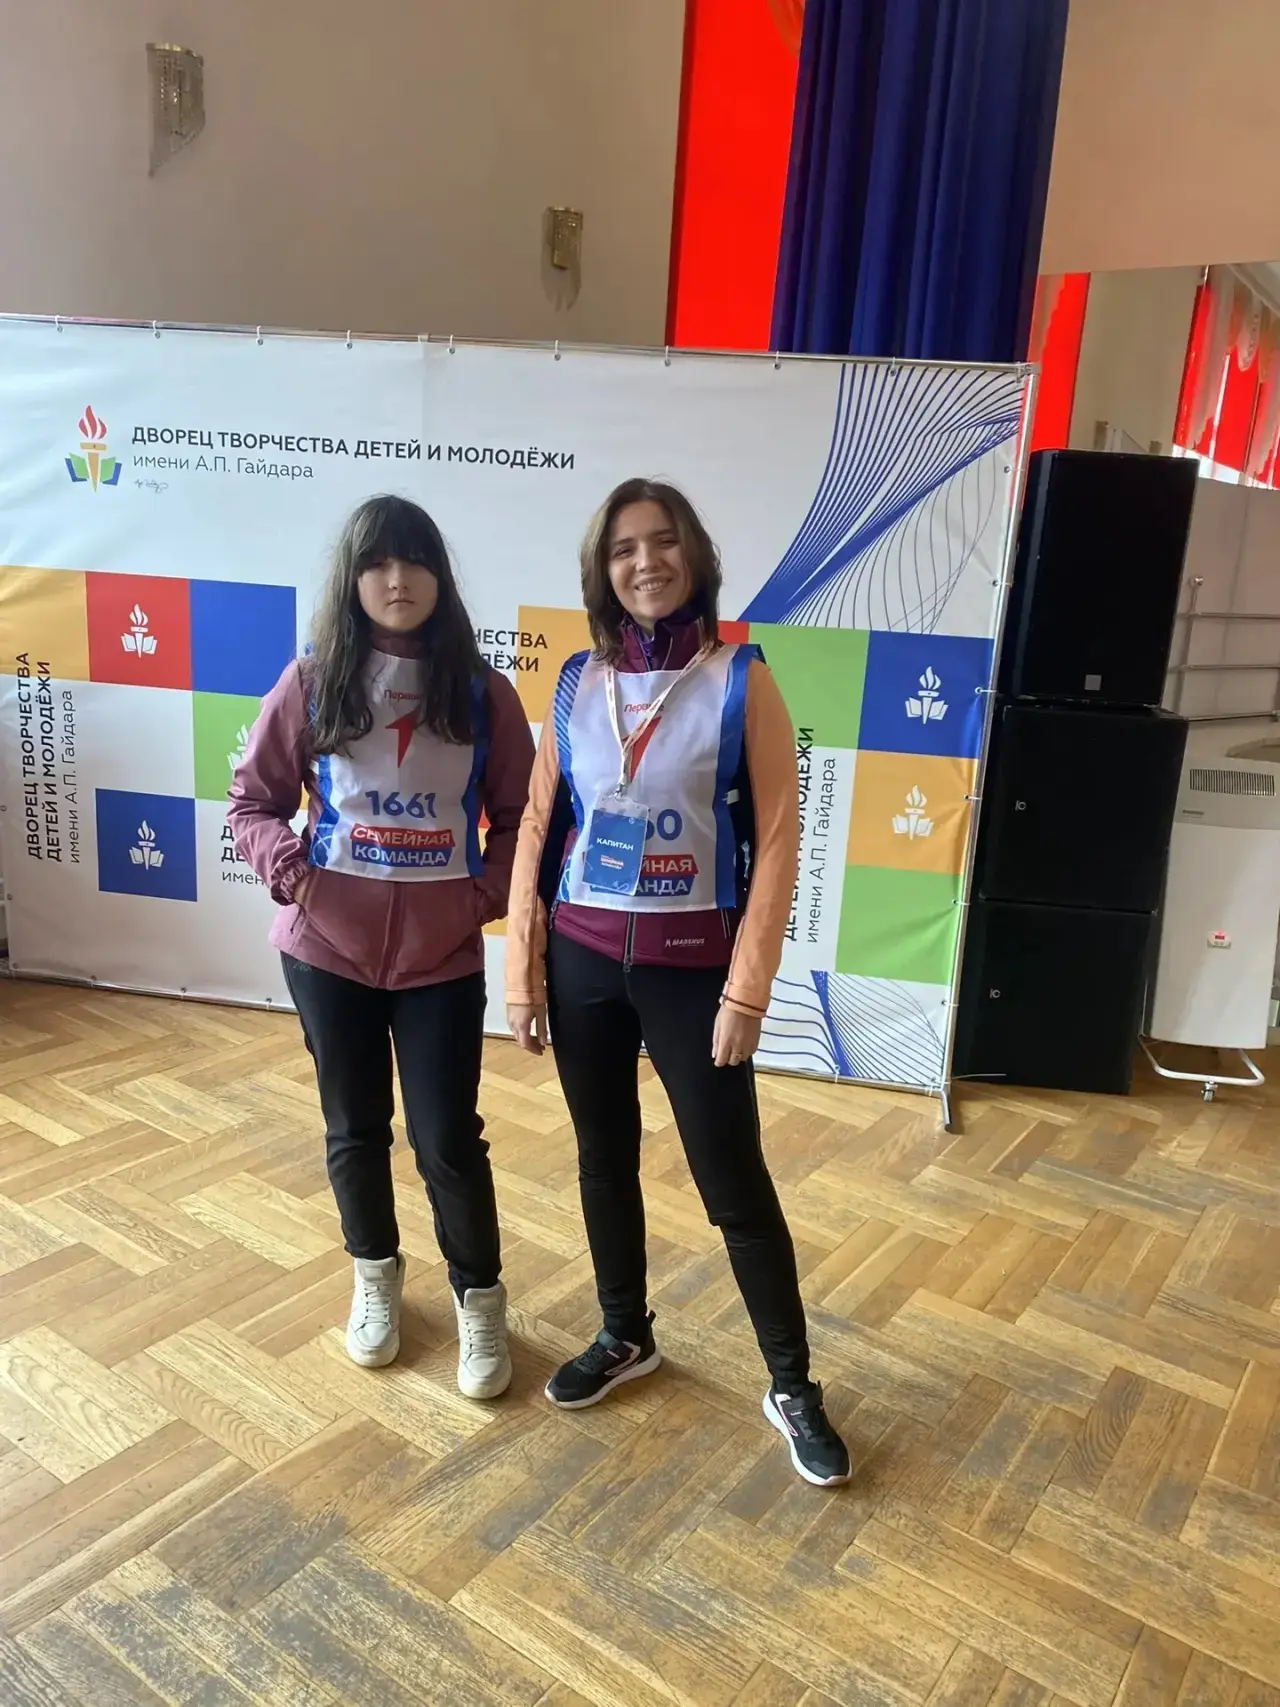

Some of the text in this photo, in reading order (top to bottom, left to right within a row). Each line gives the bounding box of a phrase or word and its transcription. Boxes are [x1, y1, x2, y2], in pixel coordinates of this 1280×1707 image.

[132, 427, 575, 469] ДВОРЕЦ ТВОРЧЕСТВА ДЕТЕЙ И МОЛОДЁЖИ
[133, 455, 314, 480] имени А.П. Гайдара
[16, 653, 43, 860] ДВОРЕЦ ТВОРЧЕСТВА
[35, 661, 62, 862] ДЕТЕЙ И МОЛОДЁЖИ
[61, 690, 80, 863] имени А.П. Гайдара
[365, 790, 437, 818] 1661
[354, 844, 447, 866] КОМАНДА
[596, 837, 634, 851] КАПИТАН
[807, 758, 837, 942] имени А.П. Гайдара
[222, 871, 264, 886] имен
